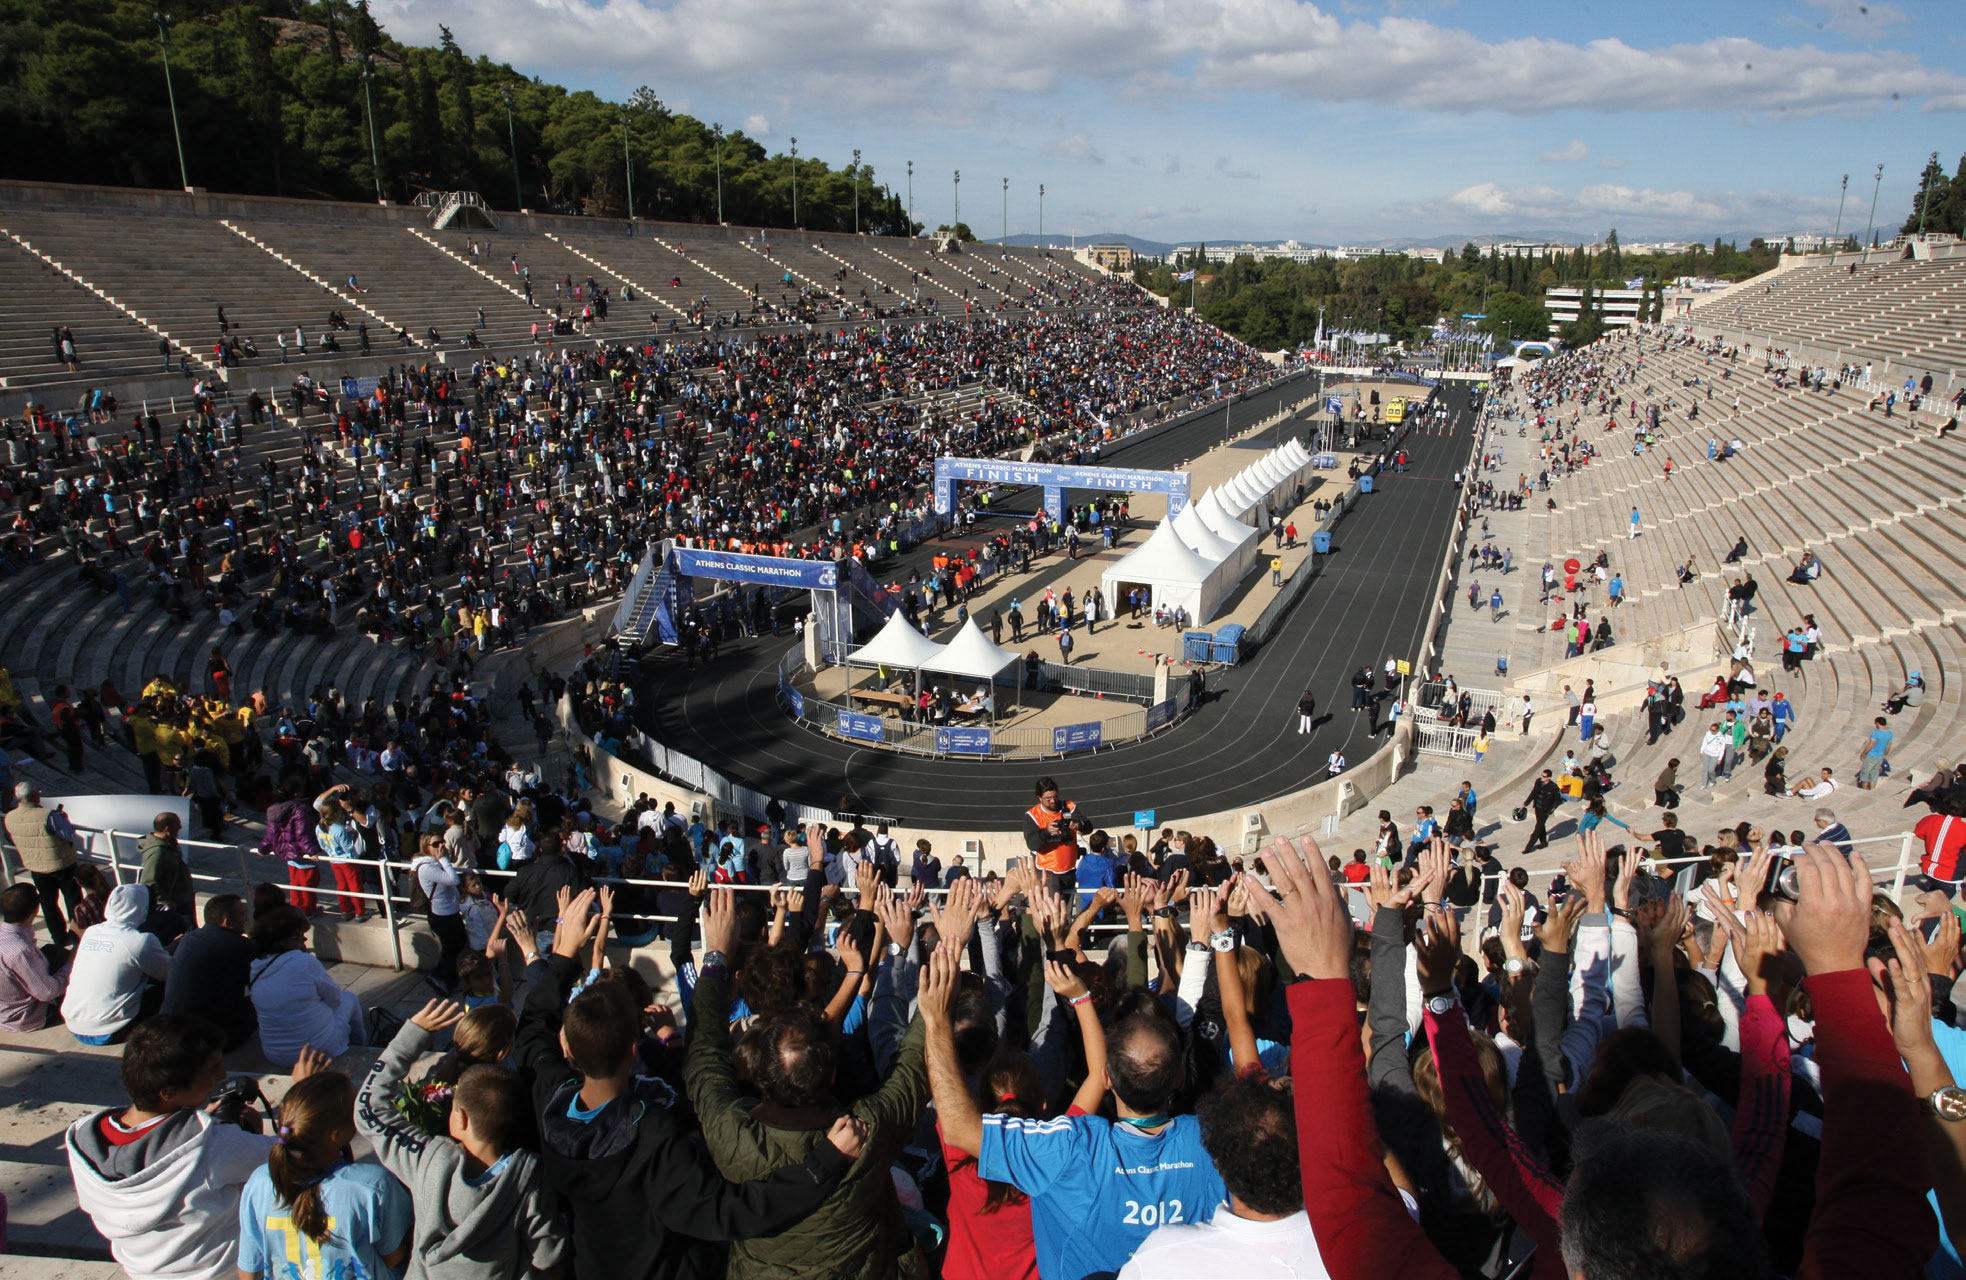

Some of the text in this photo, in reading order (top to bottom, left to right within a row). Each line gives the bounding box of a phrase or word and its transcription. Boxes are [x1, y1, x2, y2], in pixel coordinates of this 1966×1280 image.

[966, 468, 1039, 483] FINISH
[982, 464, 1011, 472] CLASSIC
[1011, 466, 1053, 475] MARATHON
[1086, 477, 1152, 490] FINISH
[695, 560, 802, 577] ATHENS CLASSIC MARATHON
[1160, 1161, 1194, 1171] Marathon
[1123, 1199, 1184, 1226] 2012
